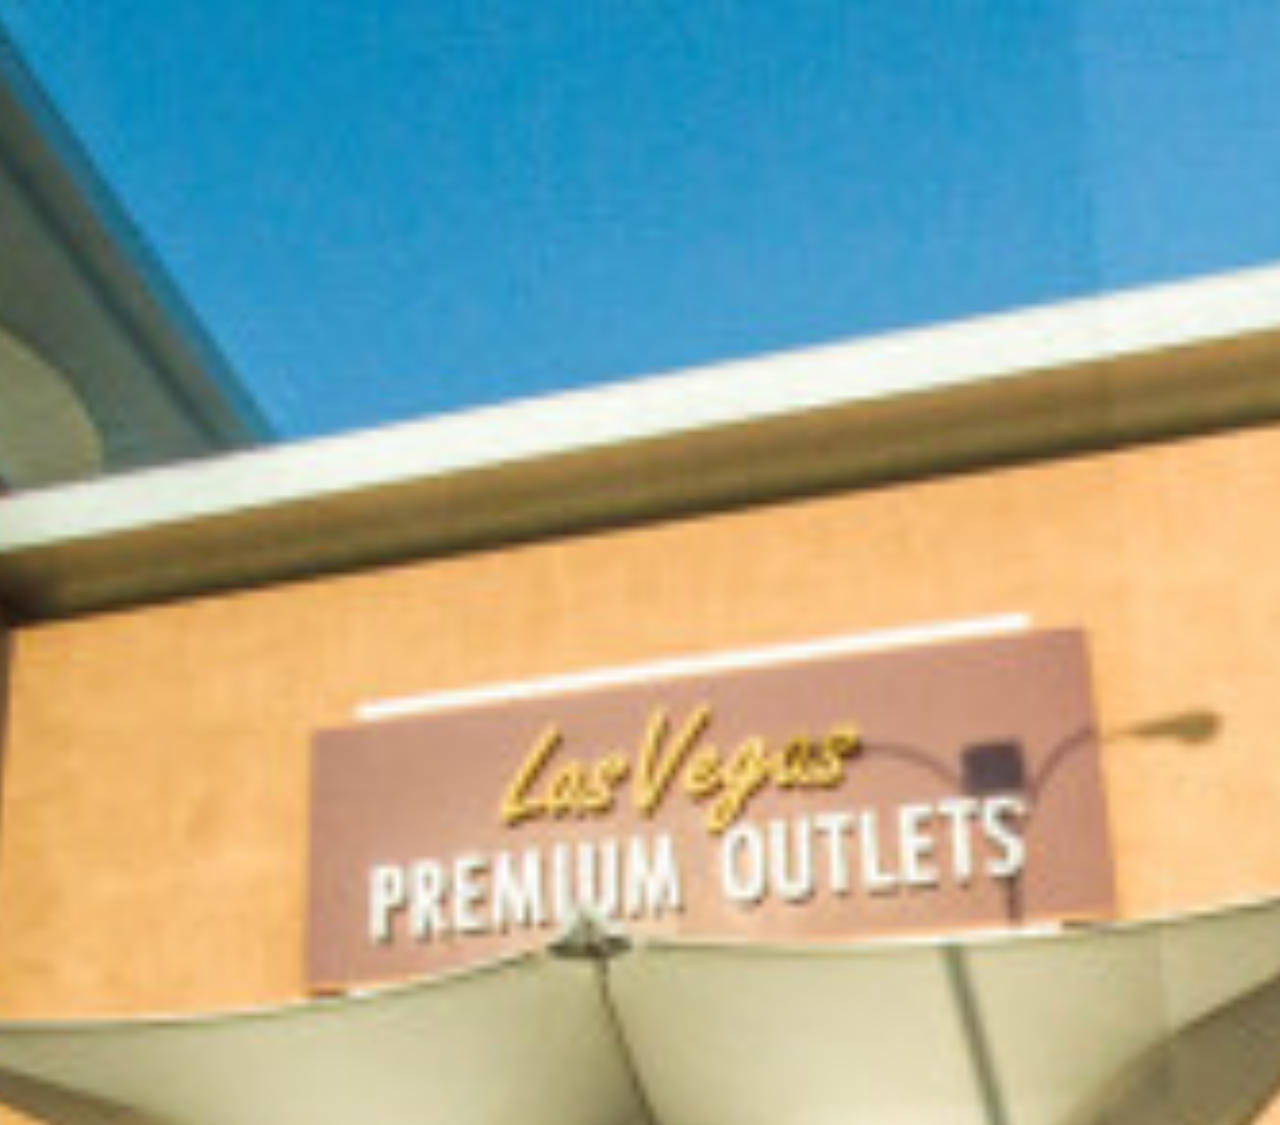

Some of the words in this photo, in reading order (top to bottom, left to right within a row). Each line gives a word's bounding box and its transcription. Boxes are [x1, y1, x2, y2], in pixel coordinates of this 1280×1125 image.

[502, 725, 630, 824] Las
[631, 699, 862, 836] Vegas
[368, 832, 684, 942] PREMIUM
[720, 796, 1028, 904] OUTLETS
